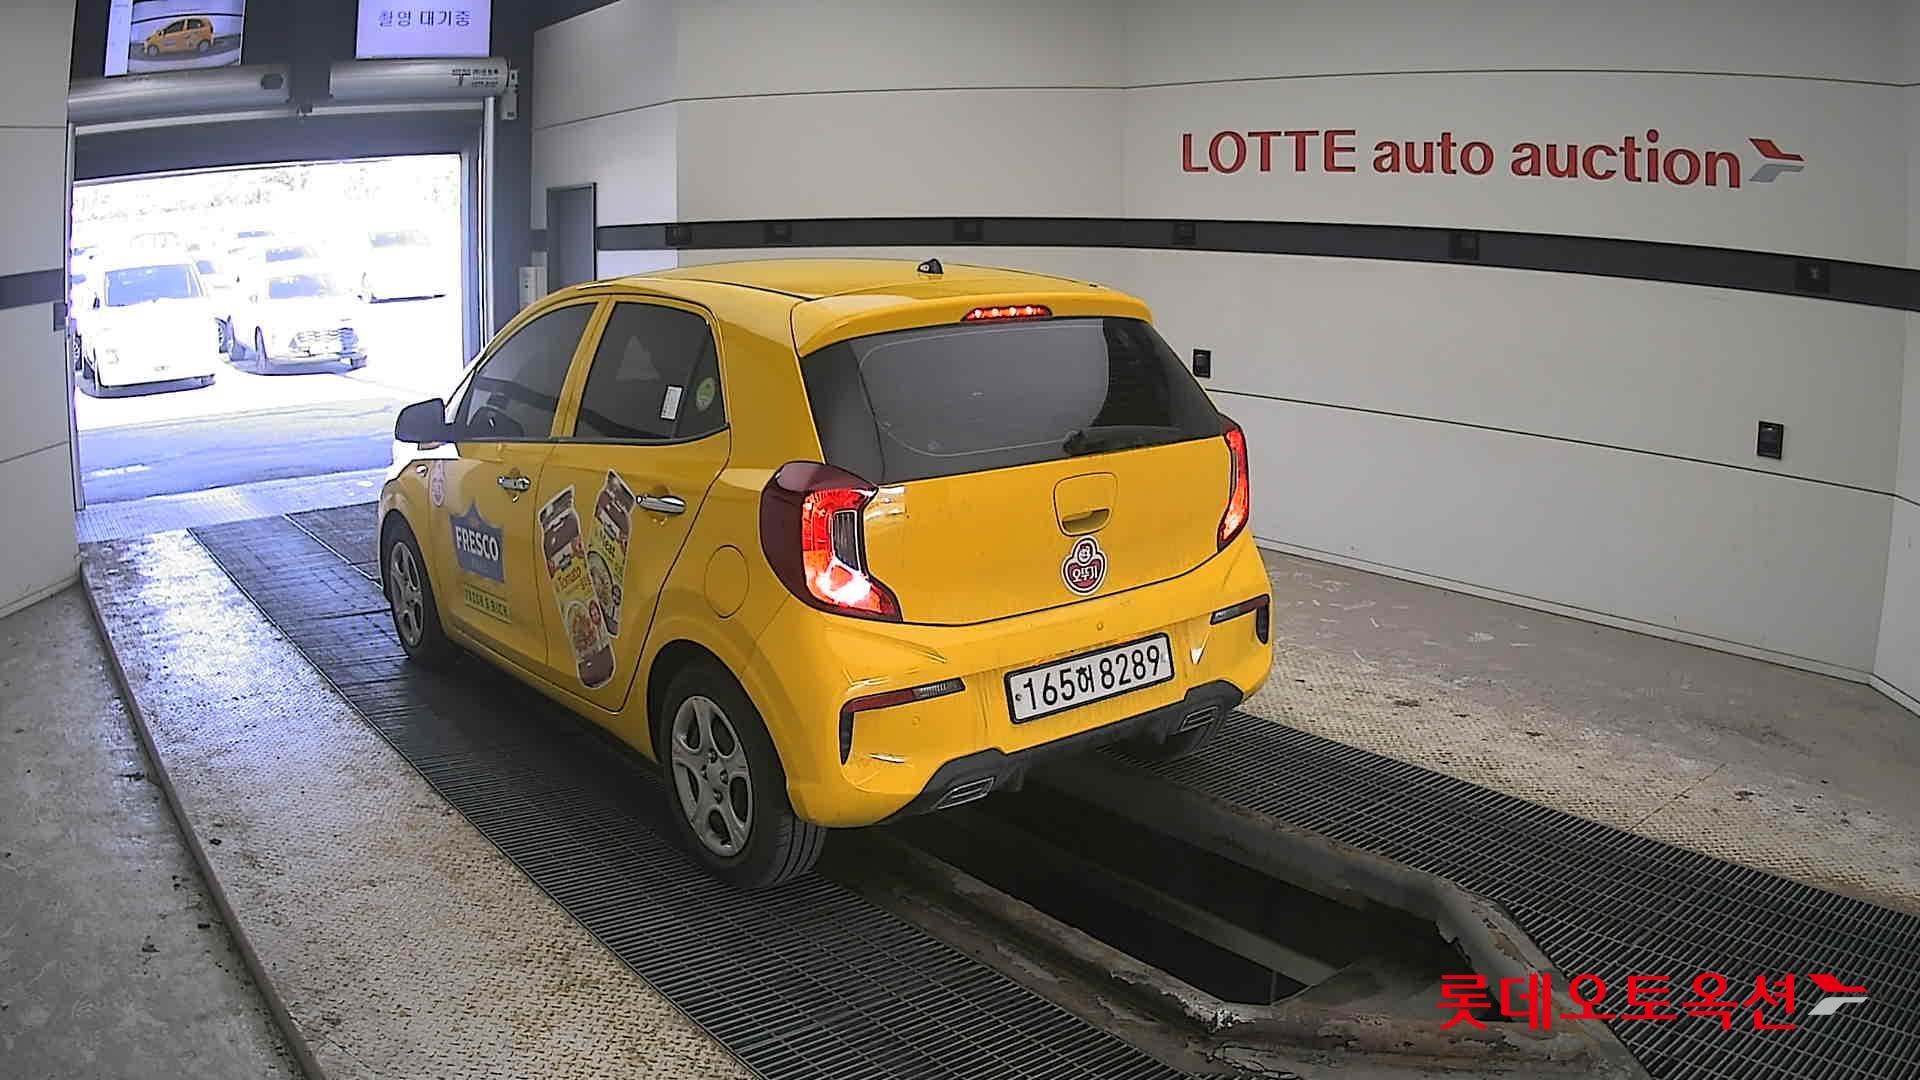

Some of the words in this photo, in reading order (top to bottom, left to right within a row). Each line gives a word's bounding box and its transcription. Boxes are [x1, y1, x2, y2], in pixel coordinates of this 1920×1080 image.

[420, 10, 471, 27] 대기중
[1182, 129, 1357, 174] LOTTE
[1373, 132, 1494, 175] auto
[1511, 129, 1741, 188] auction
[455, 526, 499, 561] FRESCO
[1100, 645, 1160, 689] 8289
